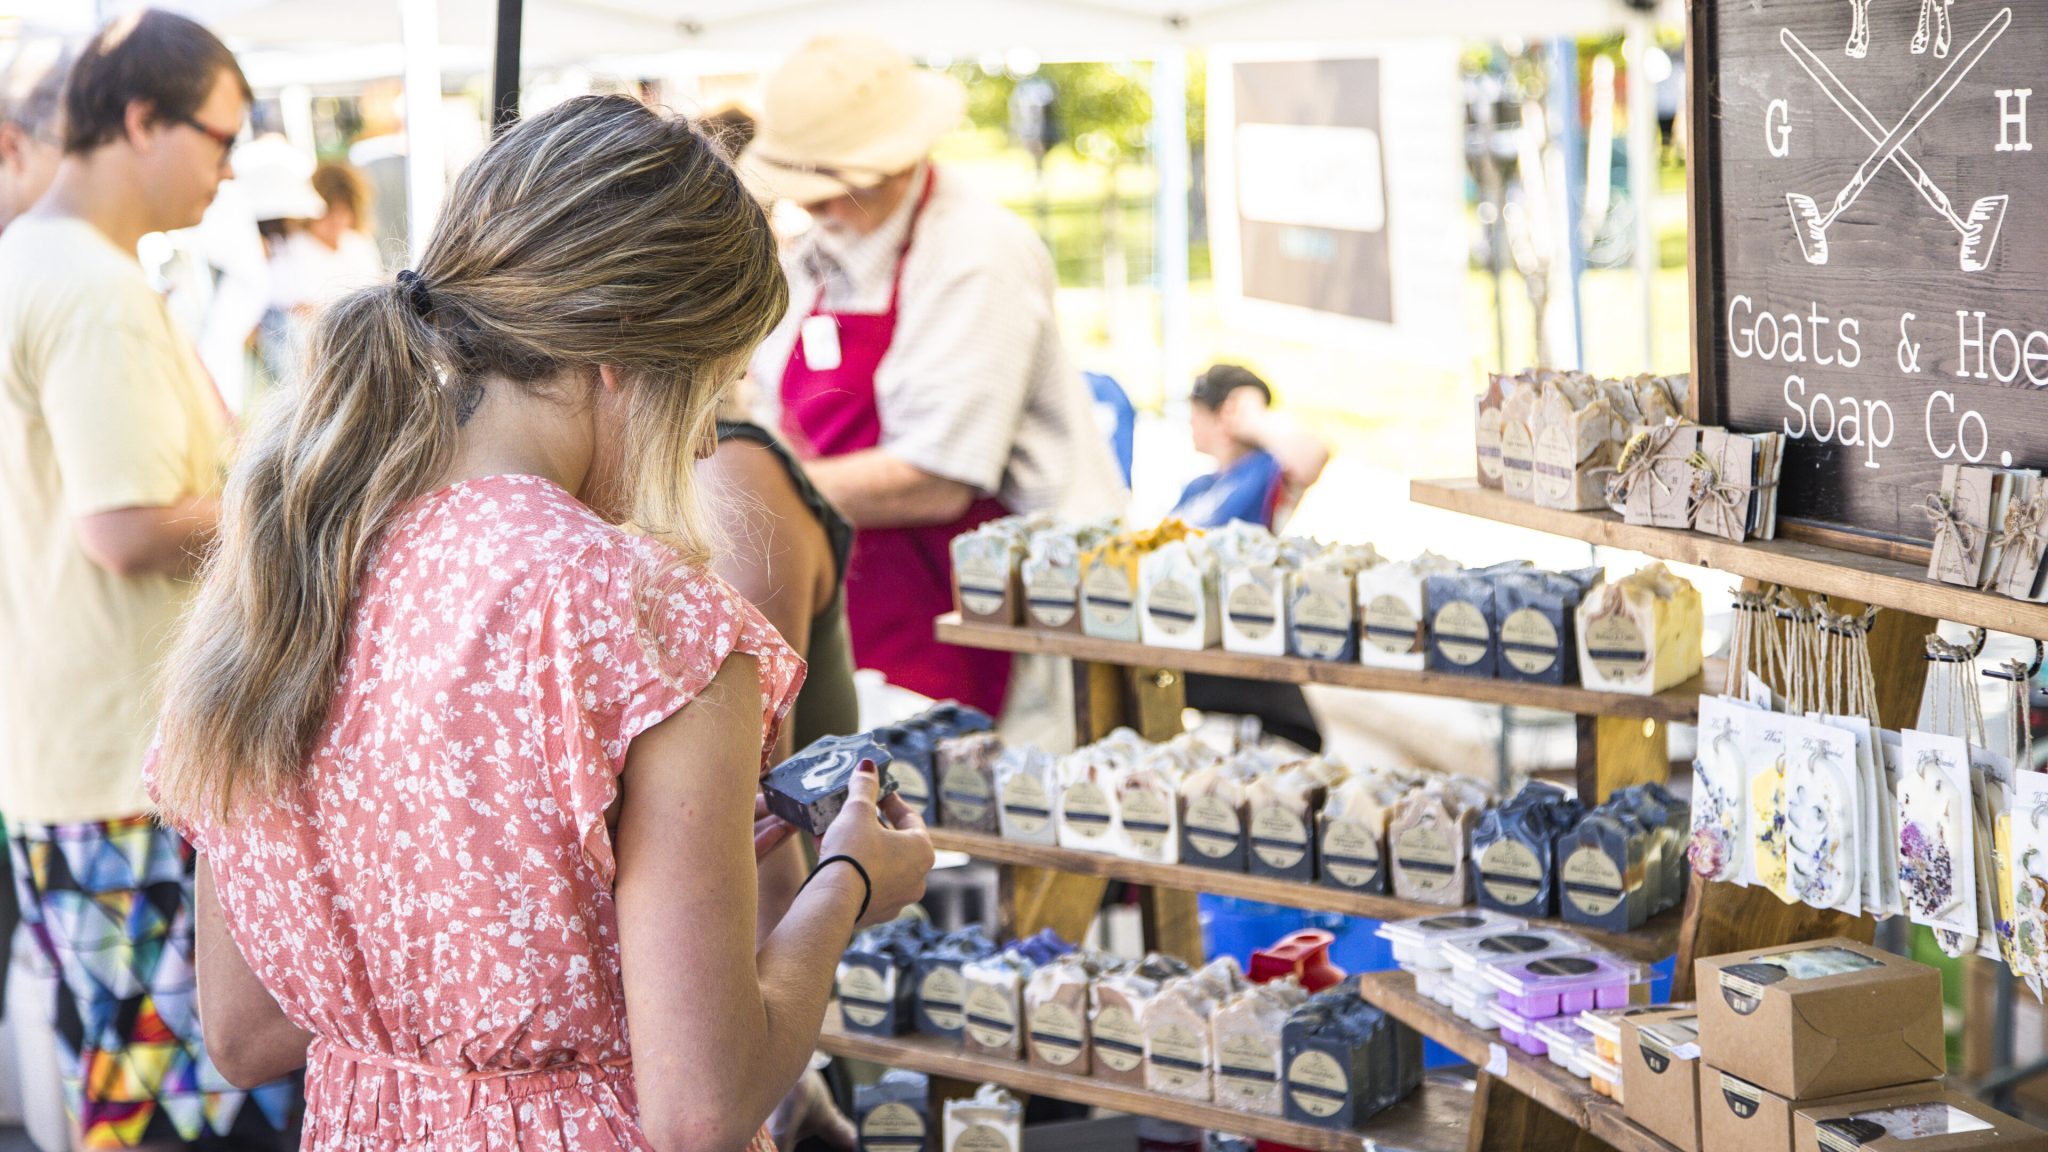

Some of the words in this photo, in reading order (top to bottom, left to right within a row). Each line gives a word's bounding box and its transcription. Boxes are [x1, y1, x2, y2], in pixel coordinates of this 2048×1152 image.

[1765, 99, 1793, 158] G
[1994, 88, 2033, 152] H
[1728, 294, 1862, 369] Goats
[1896, 311, 1921, 374] &
[1783, 374, 1895, 469] Soap
[1925, 390, 2013, 467] Co.
